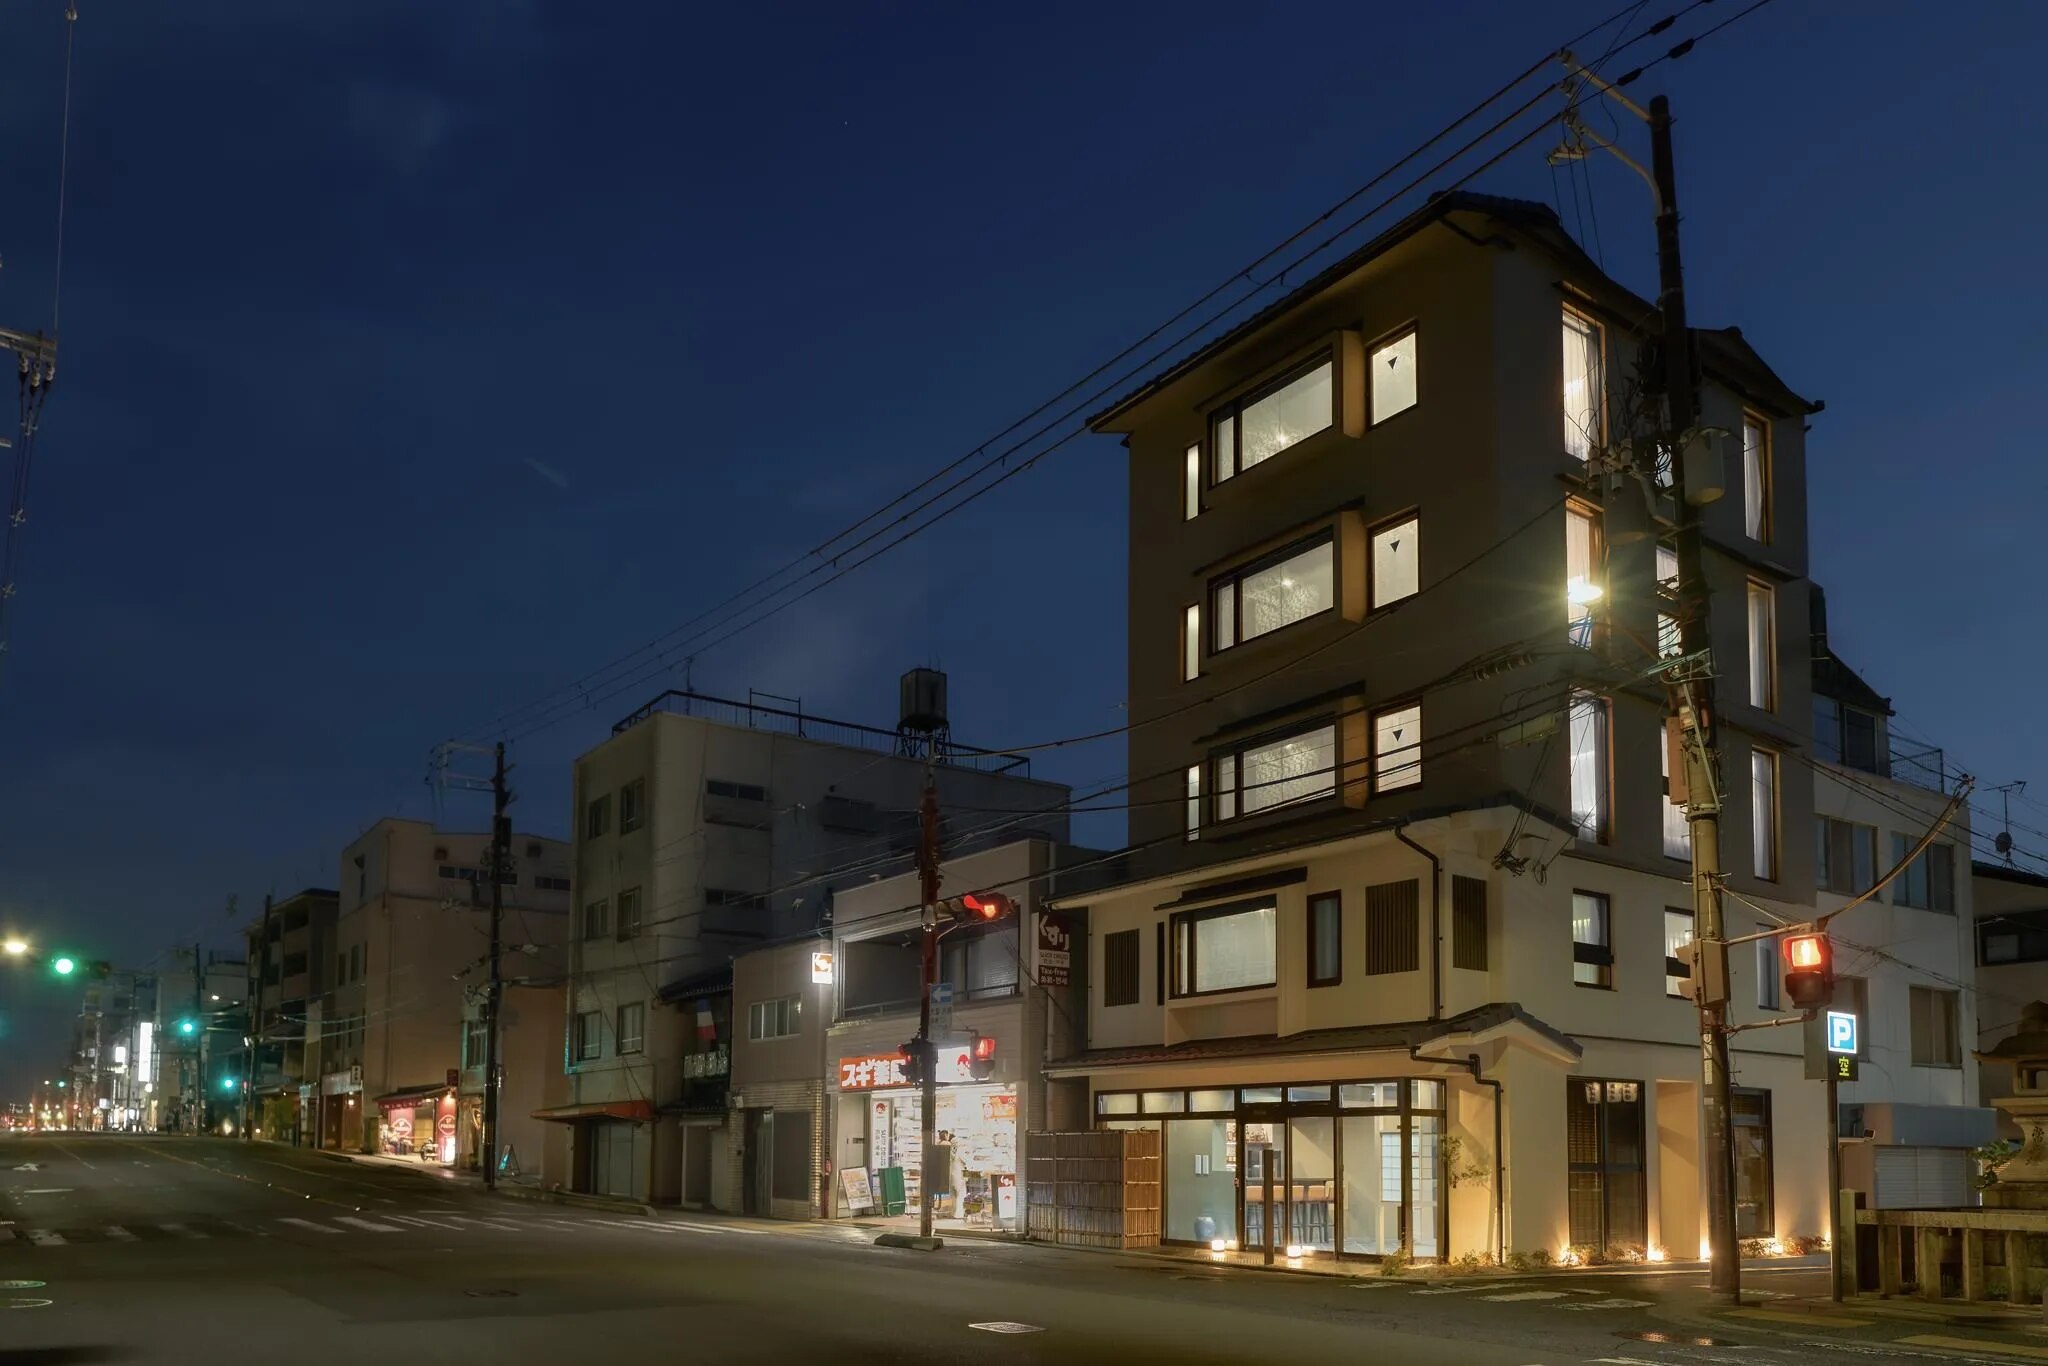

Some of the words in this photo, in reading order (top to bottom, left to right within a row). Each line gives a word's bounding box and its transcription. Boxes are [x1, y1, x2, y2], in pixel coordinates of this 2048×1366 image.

[1040, 915, 1069, 951] くすり
[1833, 1018, 1851, 1047] P
[1838, 1056, 1850, 1077] 空
